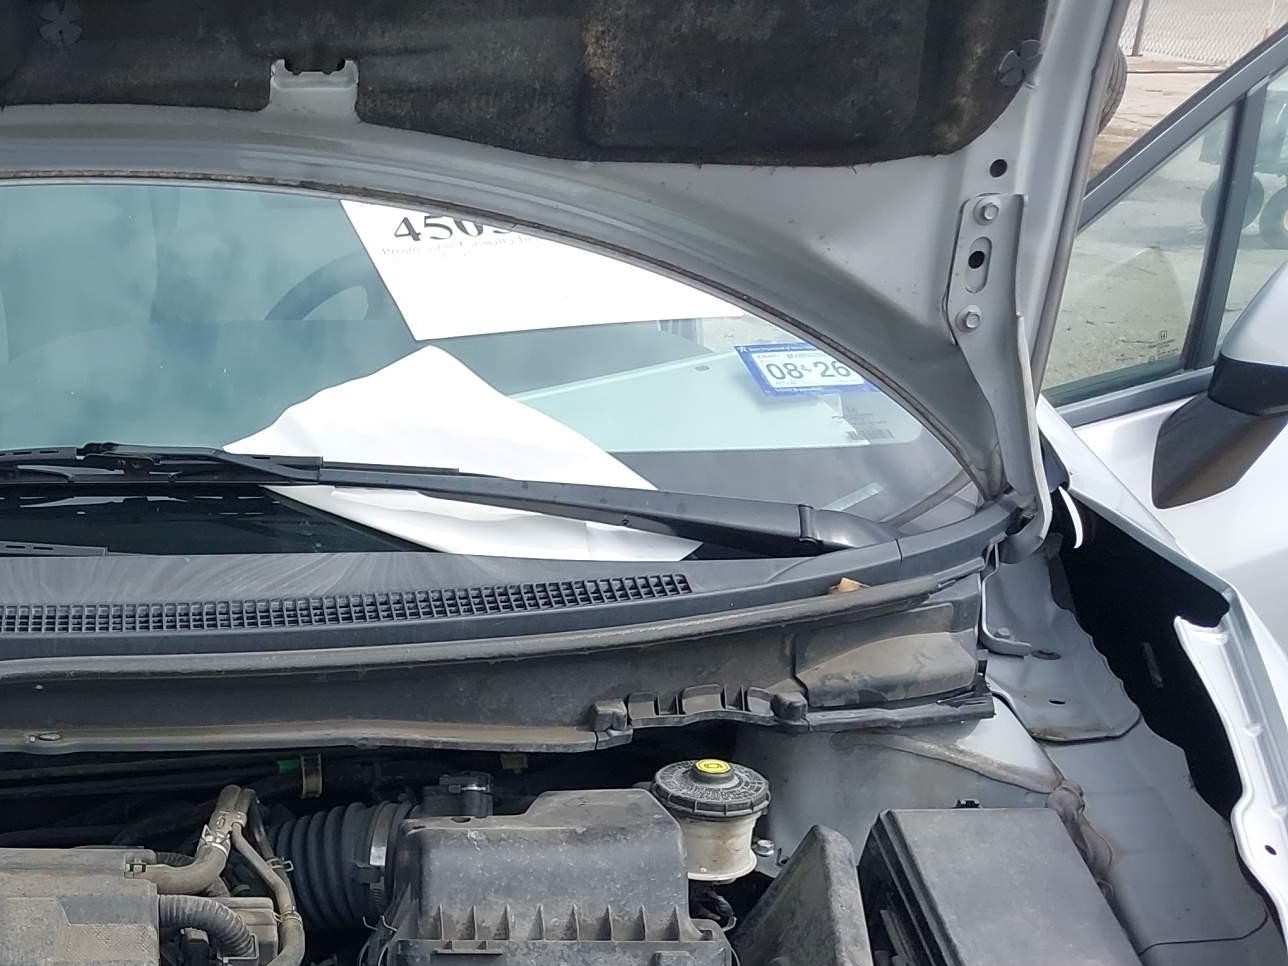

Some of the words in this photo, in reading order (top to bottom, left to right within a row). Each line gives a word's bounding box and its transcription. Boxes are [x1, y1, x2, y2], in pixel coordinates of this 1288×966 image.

[394, 216, 513, 241] 450
[766, 362, 804, 380] 08
[813, 360, 851, 378] 26
